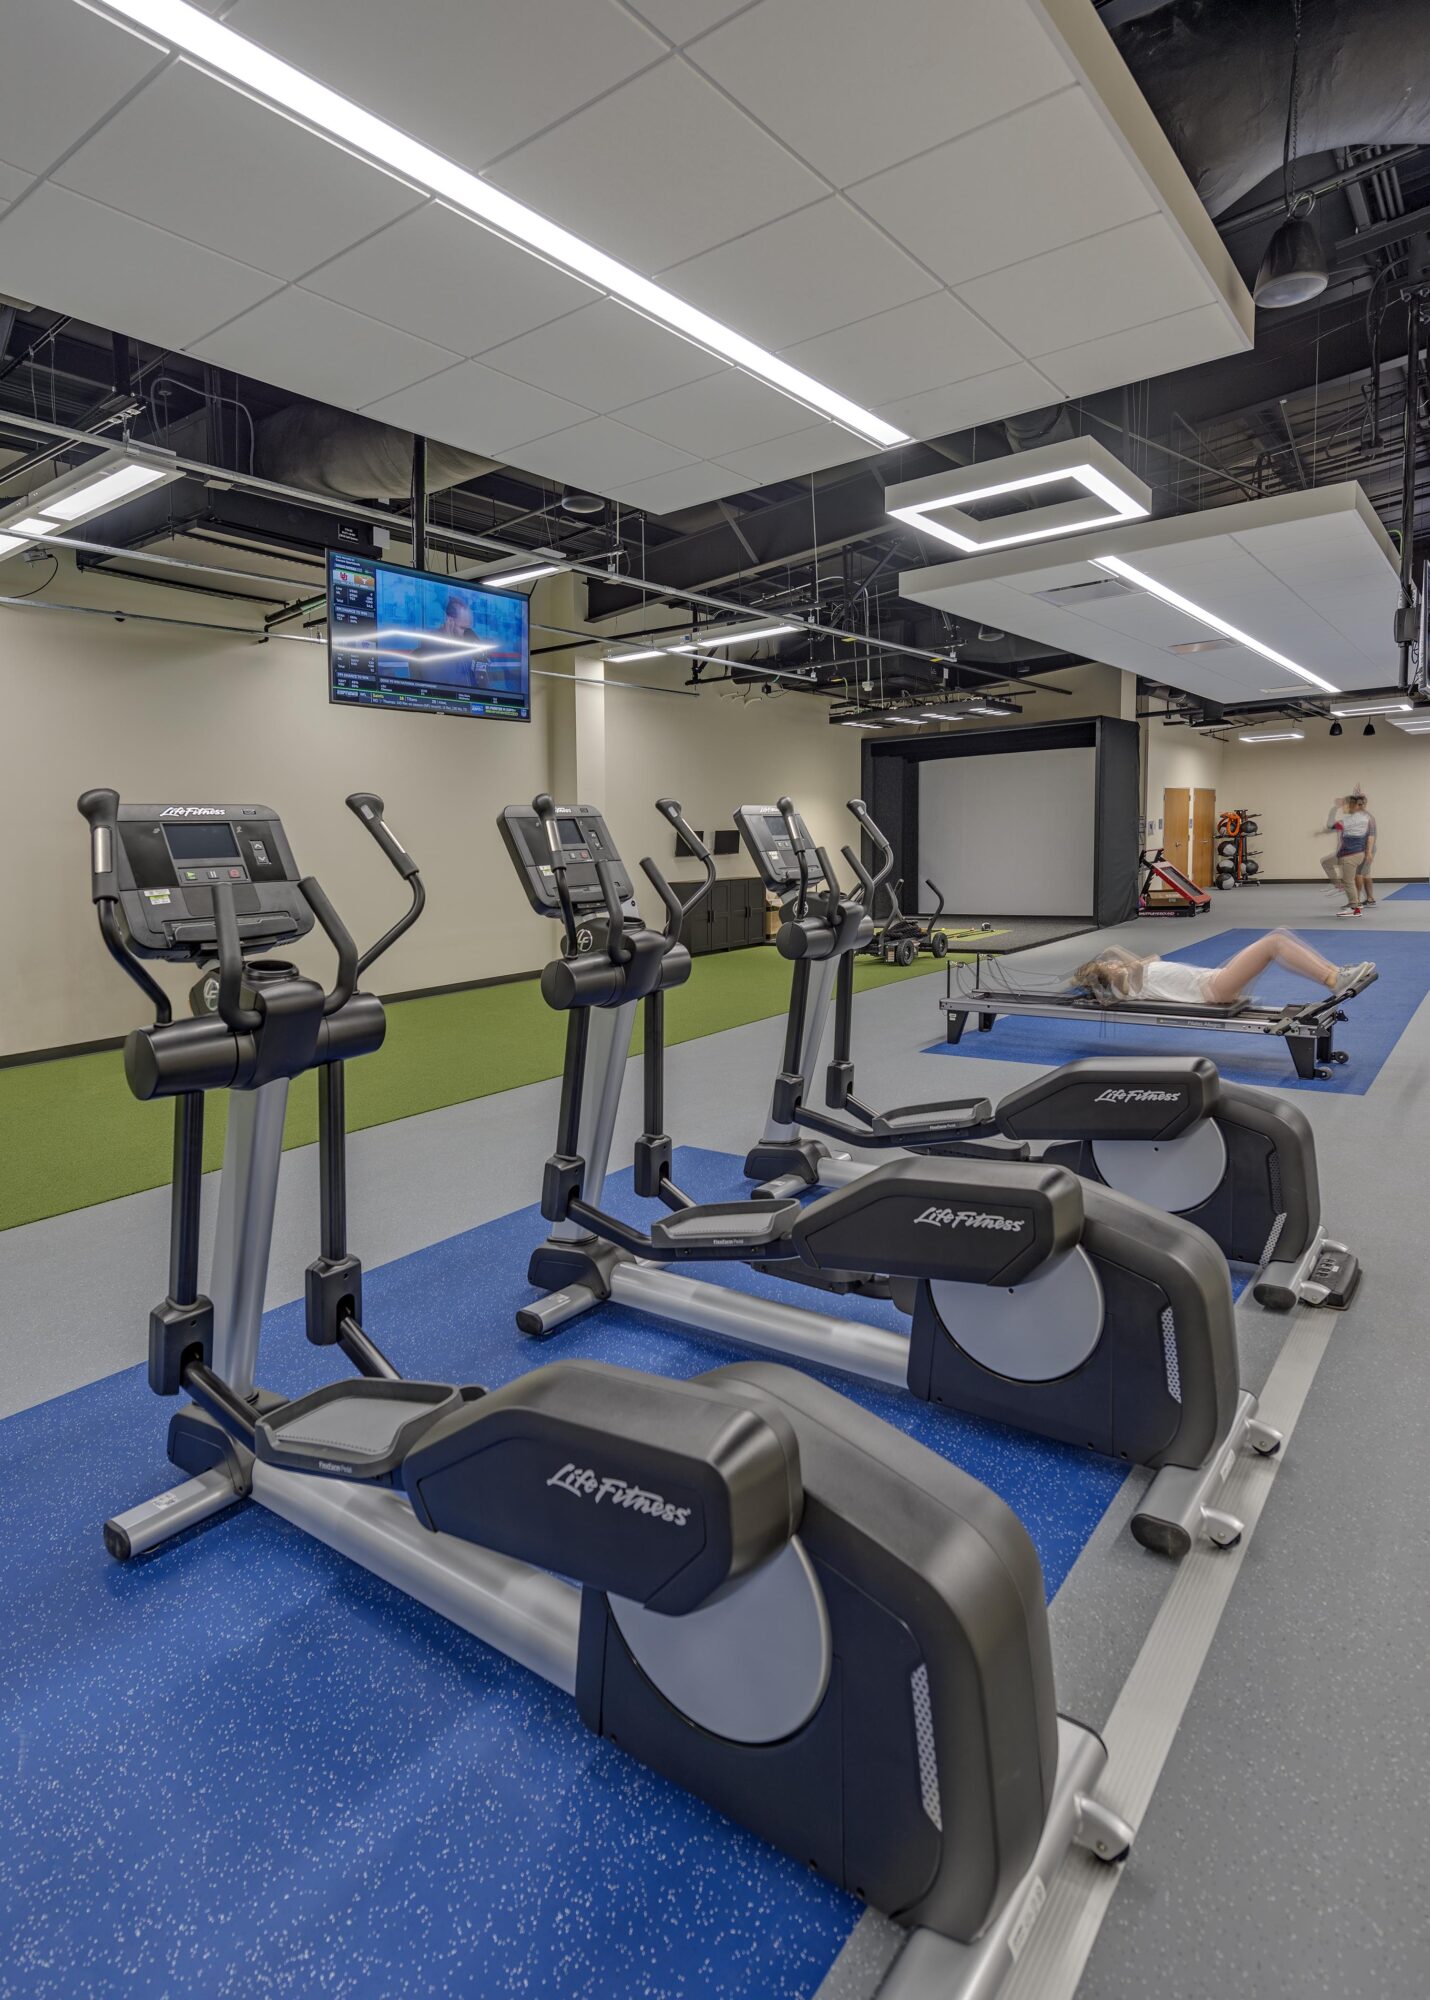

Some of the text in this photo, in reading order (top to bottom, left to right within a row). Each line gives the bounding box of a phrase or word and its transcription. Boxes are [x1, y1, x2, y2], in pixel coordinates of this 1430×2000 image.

[1094, 1089, 1181, 1103] Life Fitness
[914, 1206, 1025, 1232] Life Fitness
[546, 1463, 691, 1526] Life Fitness
